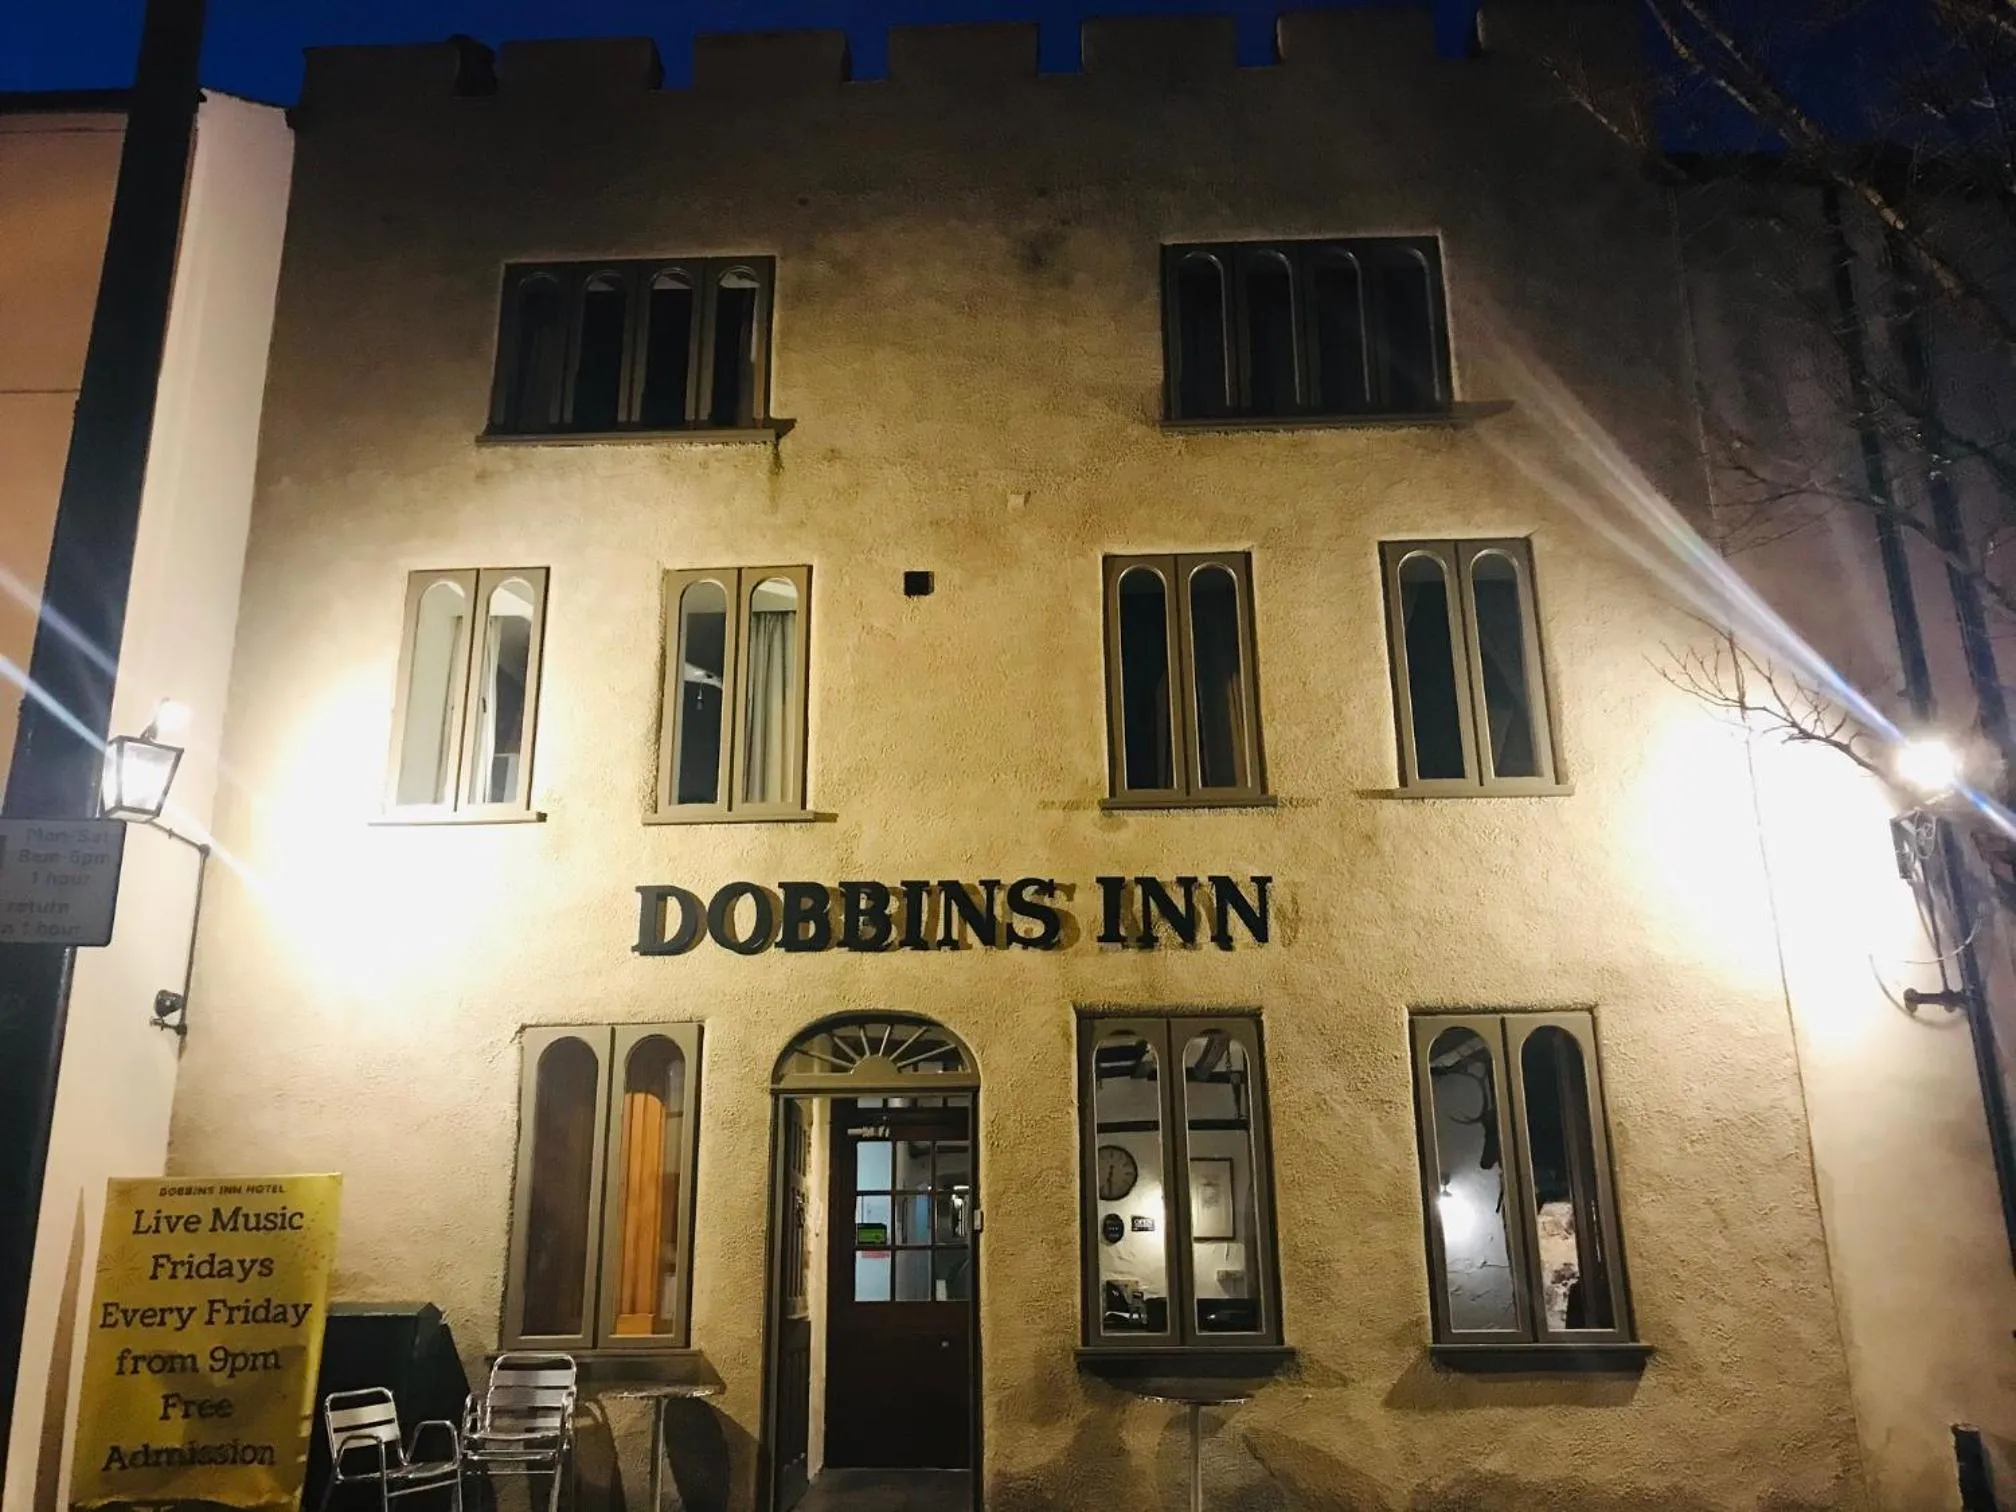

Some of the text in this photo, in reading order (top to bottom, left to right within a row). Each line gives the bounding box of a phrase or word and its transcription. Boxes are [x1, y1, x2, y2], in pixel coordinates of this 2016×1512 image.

[46, 870, 91, 886] hour
[6, 899, 71, 914] return
[631, 874, 1275, 957] DOBBINS INN
[36, 920, 82, 937] hour
[159, 1183, 286, 1197] DOBBINS INN HOTEL
[132, 1205, 305, 1236] Live Music
[149, 1252, 275, 1283] Fridays
[100, 1299, 313, 1331] Every Friday
[115, 1345, 282, 1379] from 9pm
[159, 1392, 235, 1421] Free
[102, 1440, 277, 1472] Admission
